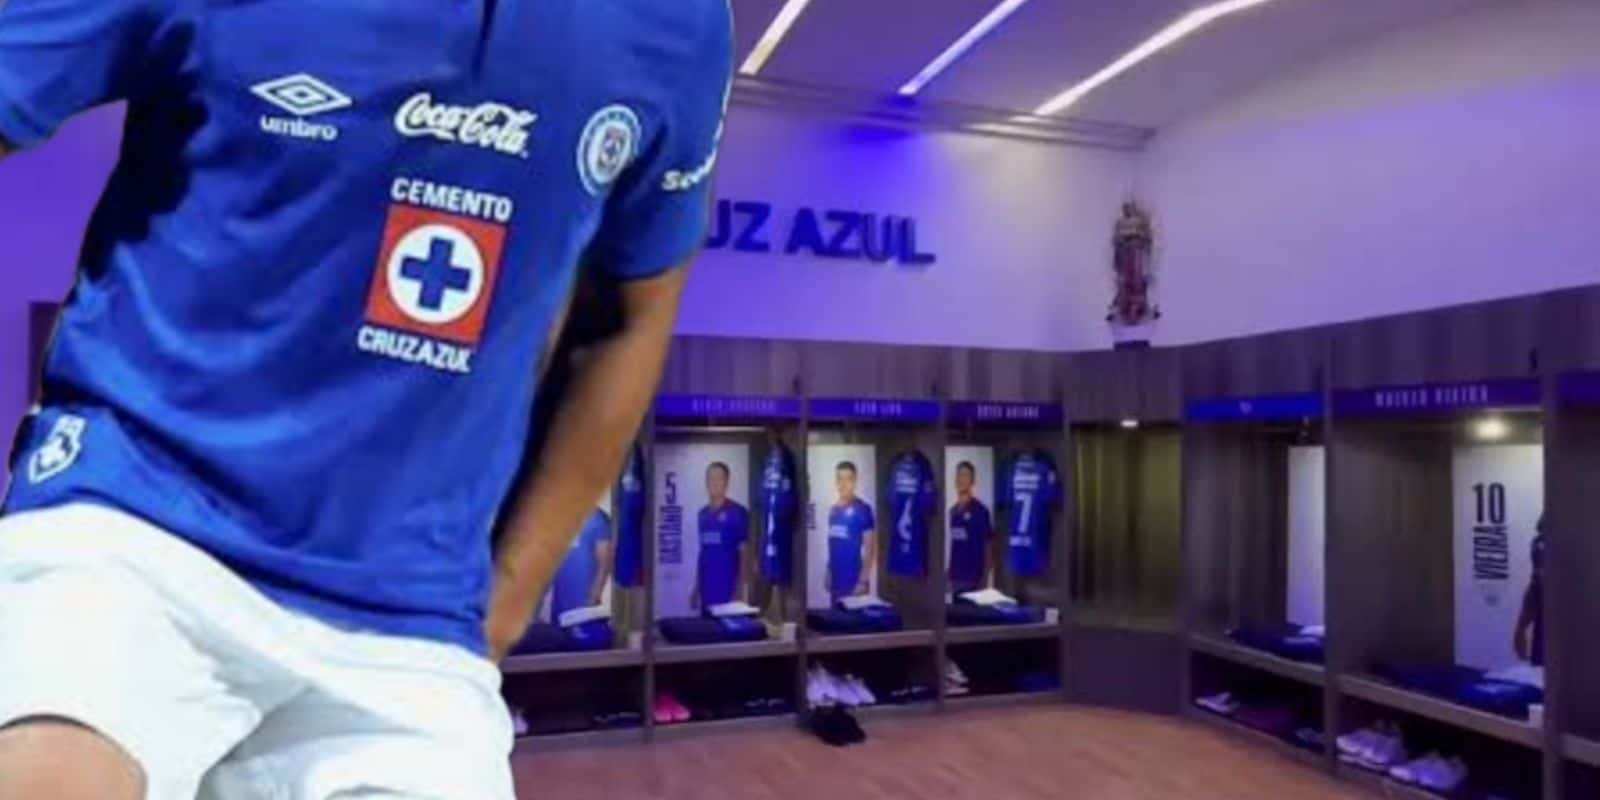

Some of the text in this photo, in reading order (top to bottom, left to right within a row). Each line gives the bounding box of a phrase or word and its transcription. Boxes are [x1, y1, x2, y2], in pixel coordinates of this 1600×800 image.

[260, 115, 339, 141] umbro
[391, 177, 513, 222] CEMENTO
[785, 207, 936, 265] AZUL
[664, 471, 676, 501] 5
[1472, 483, 1506, 525] 10
[1013, 494, 1032, 533] 7
